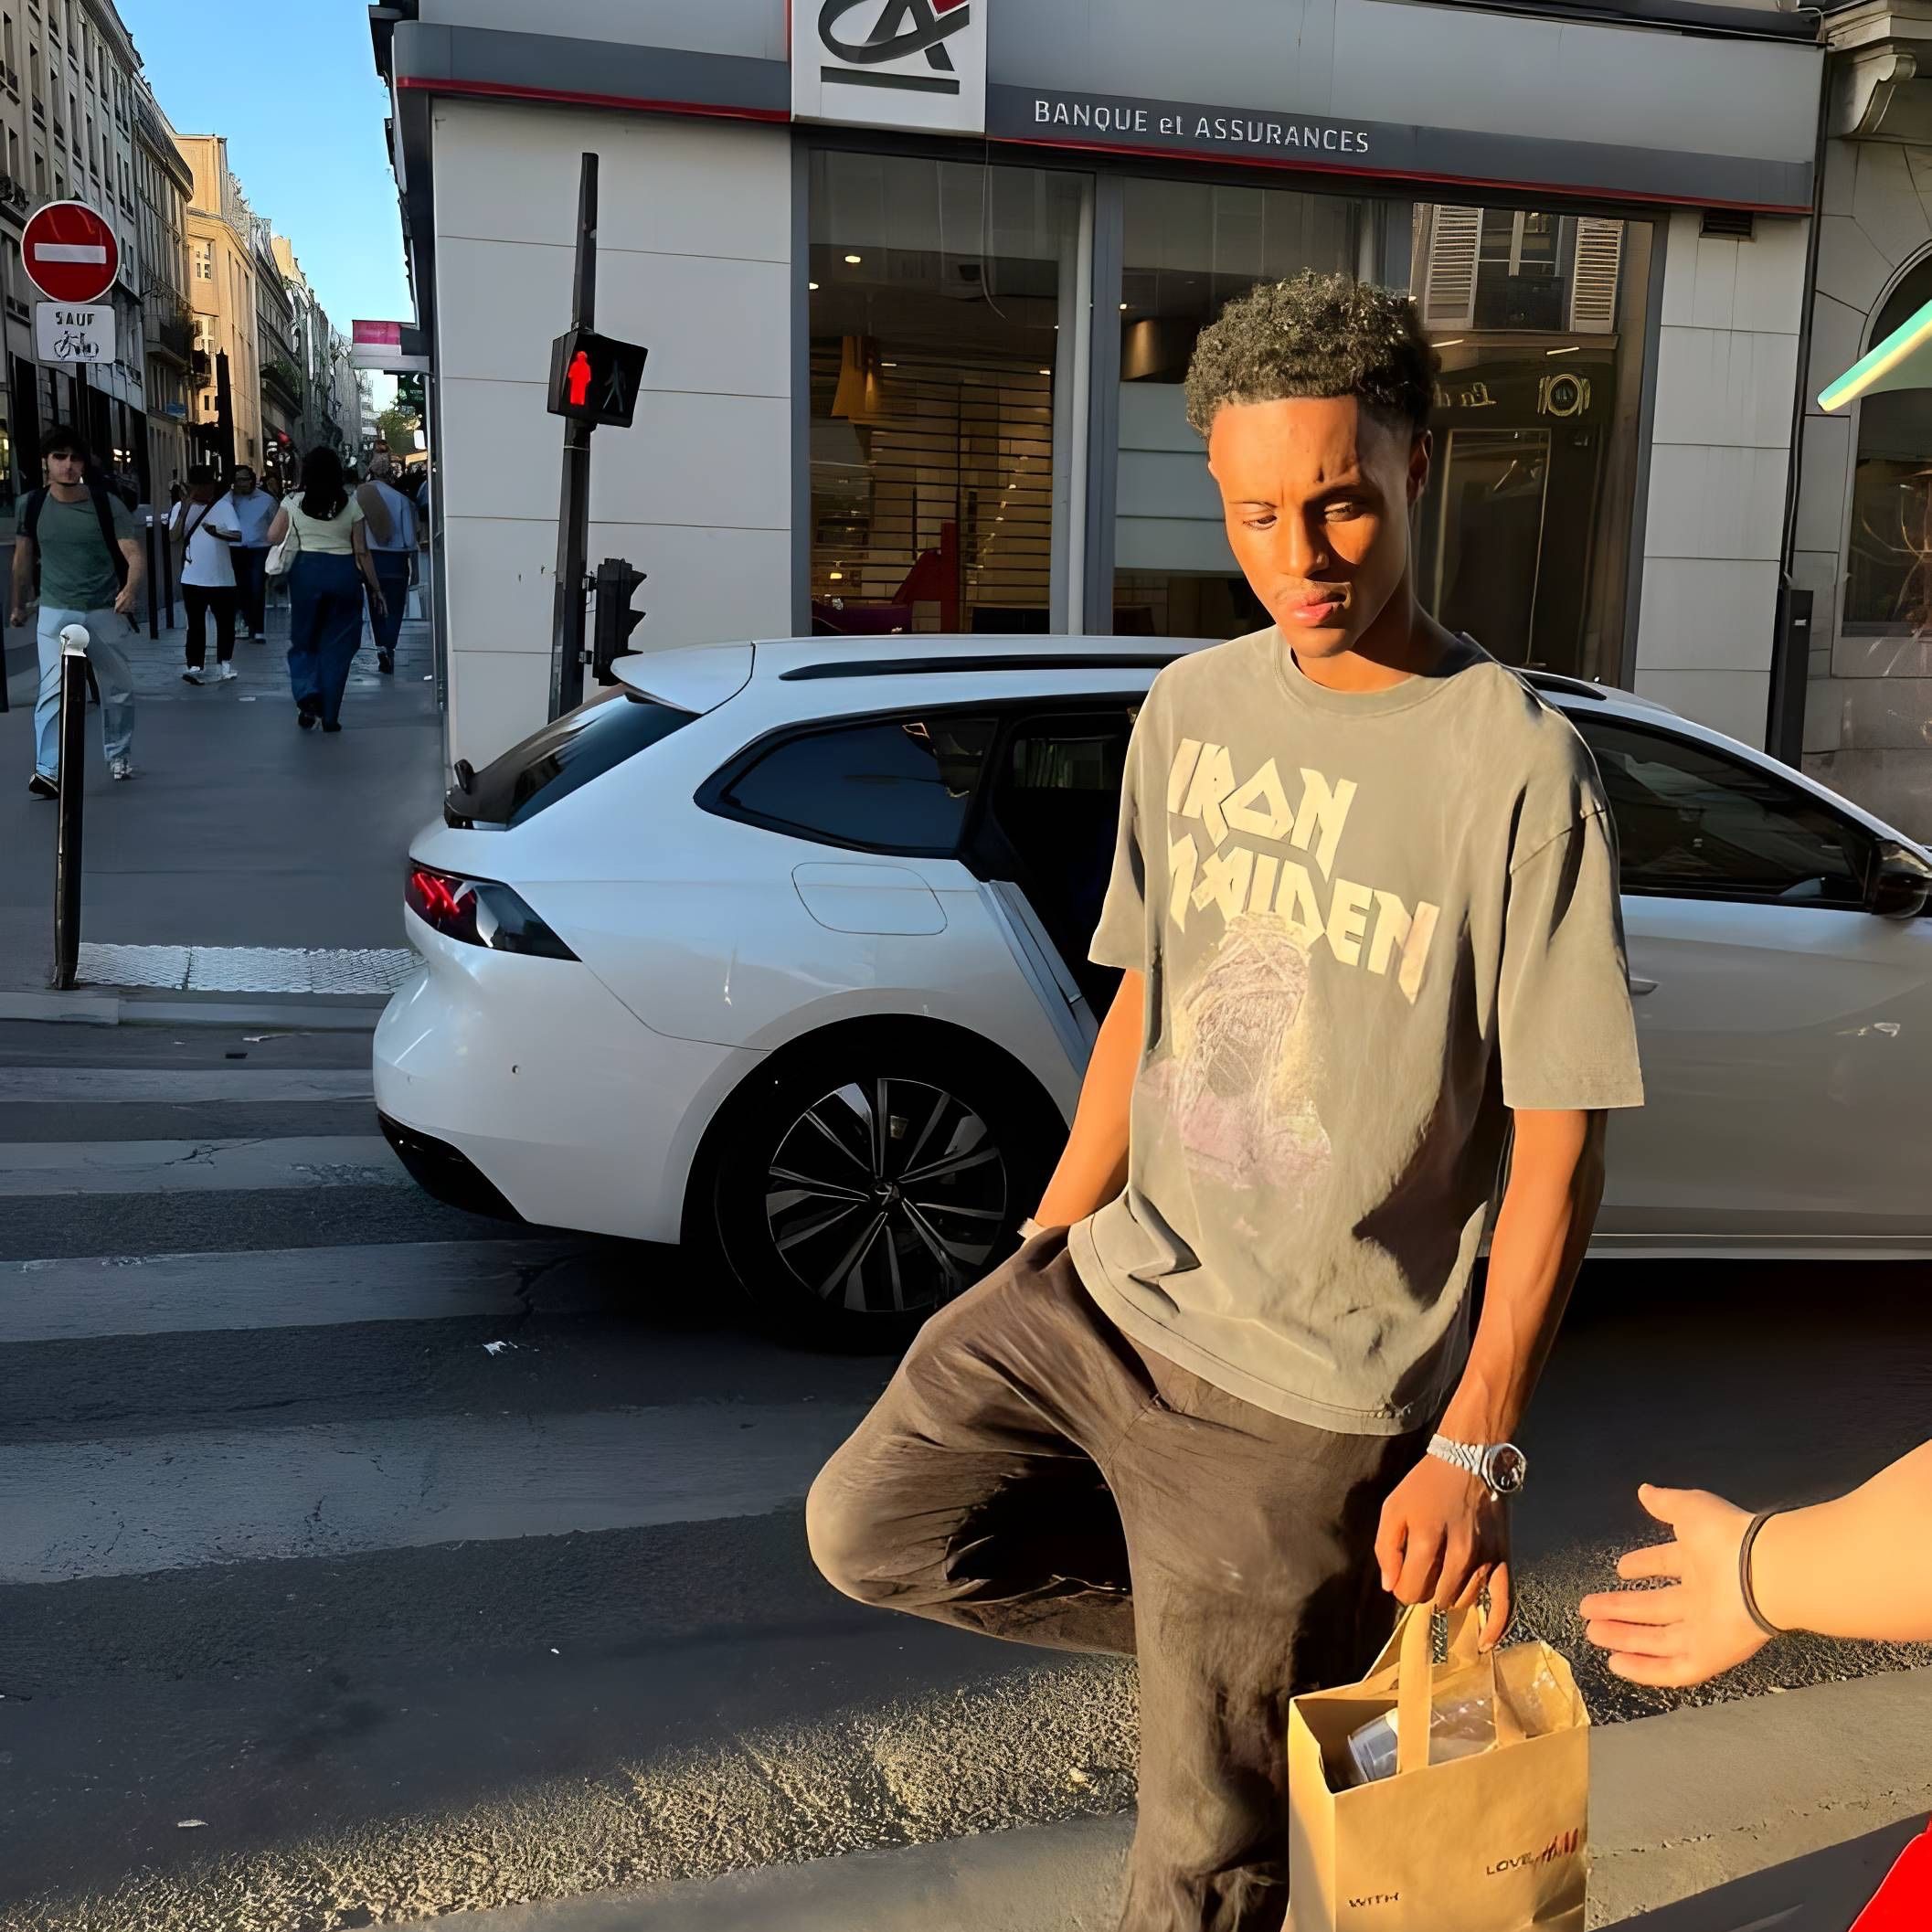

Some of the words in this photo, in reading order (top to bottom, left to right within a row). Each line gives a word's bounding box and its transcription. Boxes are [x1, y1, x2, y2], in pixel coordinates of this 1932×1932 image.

[1035, 100, 1148, 133] BANQUE
[1160, 115, 1184, 136] et
[1194, 116, 1369, 154] ASSURANCES
[55, 311, 95, 326] SAUF
[1167, 738, 1359, 885] IRON
[1168, 830, 1440, 1005] MAIDEN
[1348, 1891, 1400, 1908] WITH
